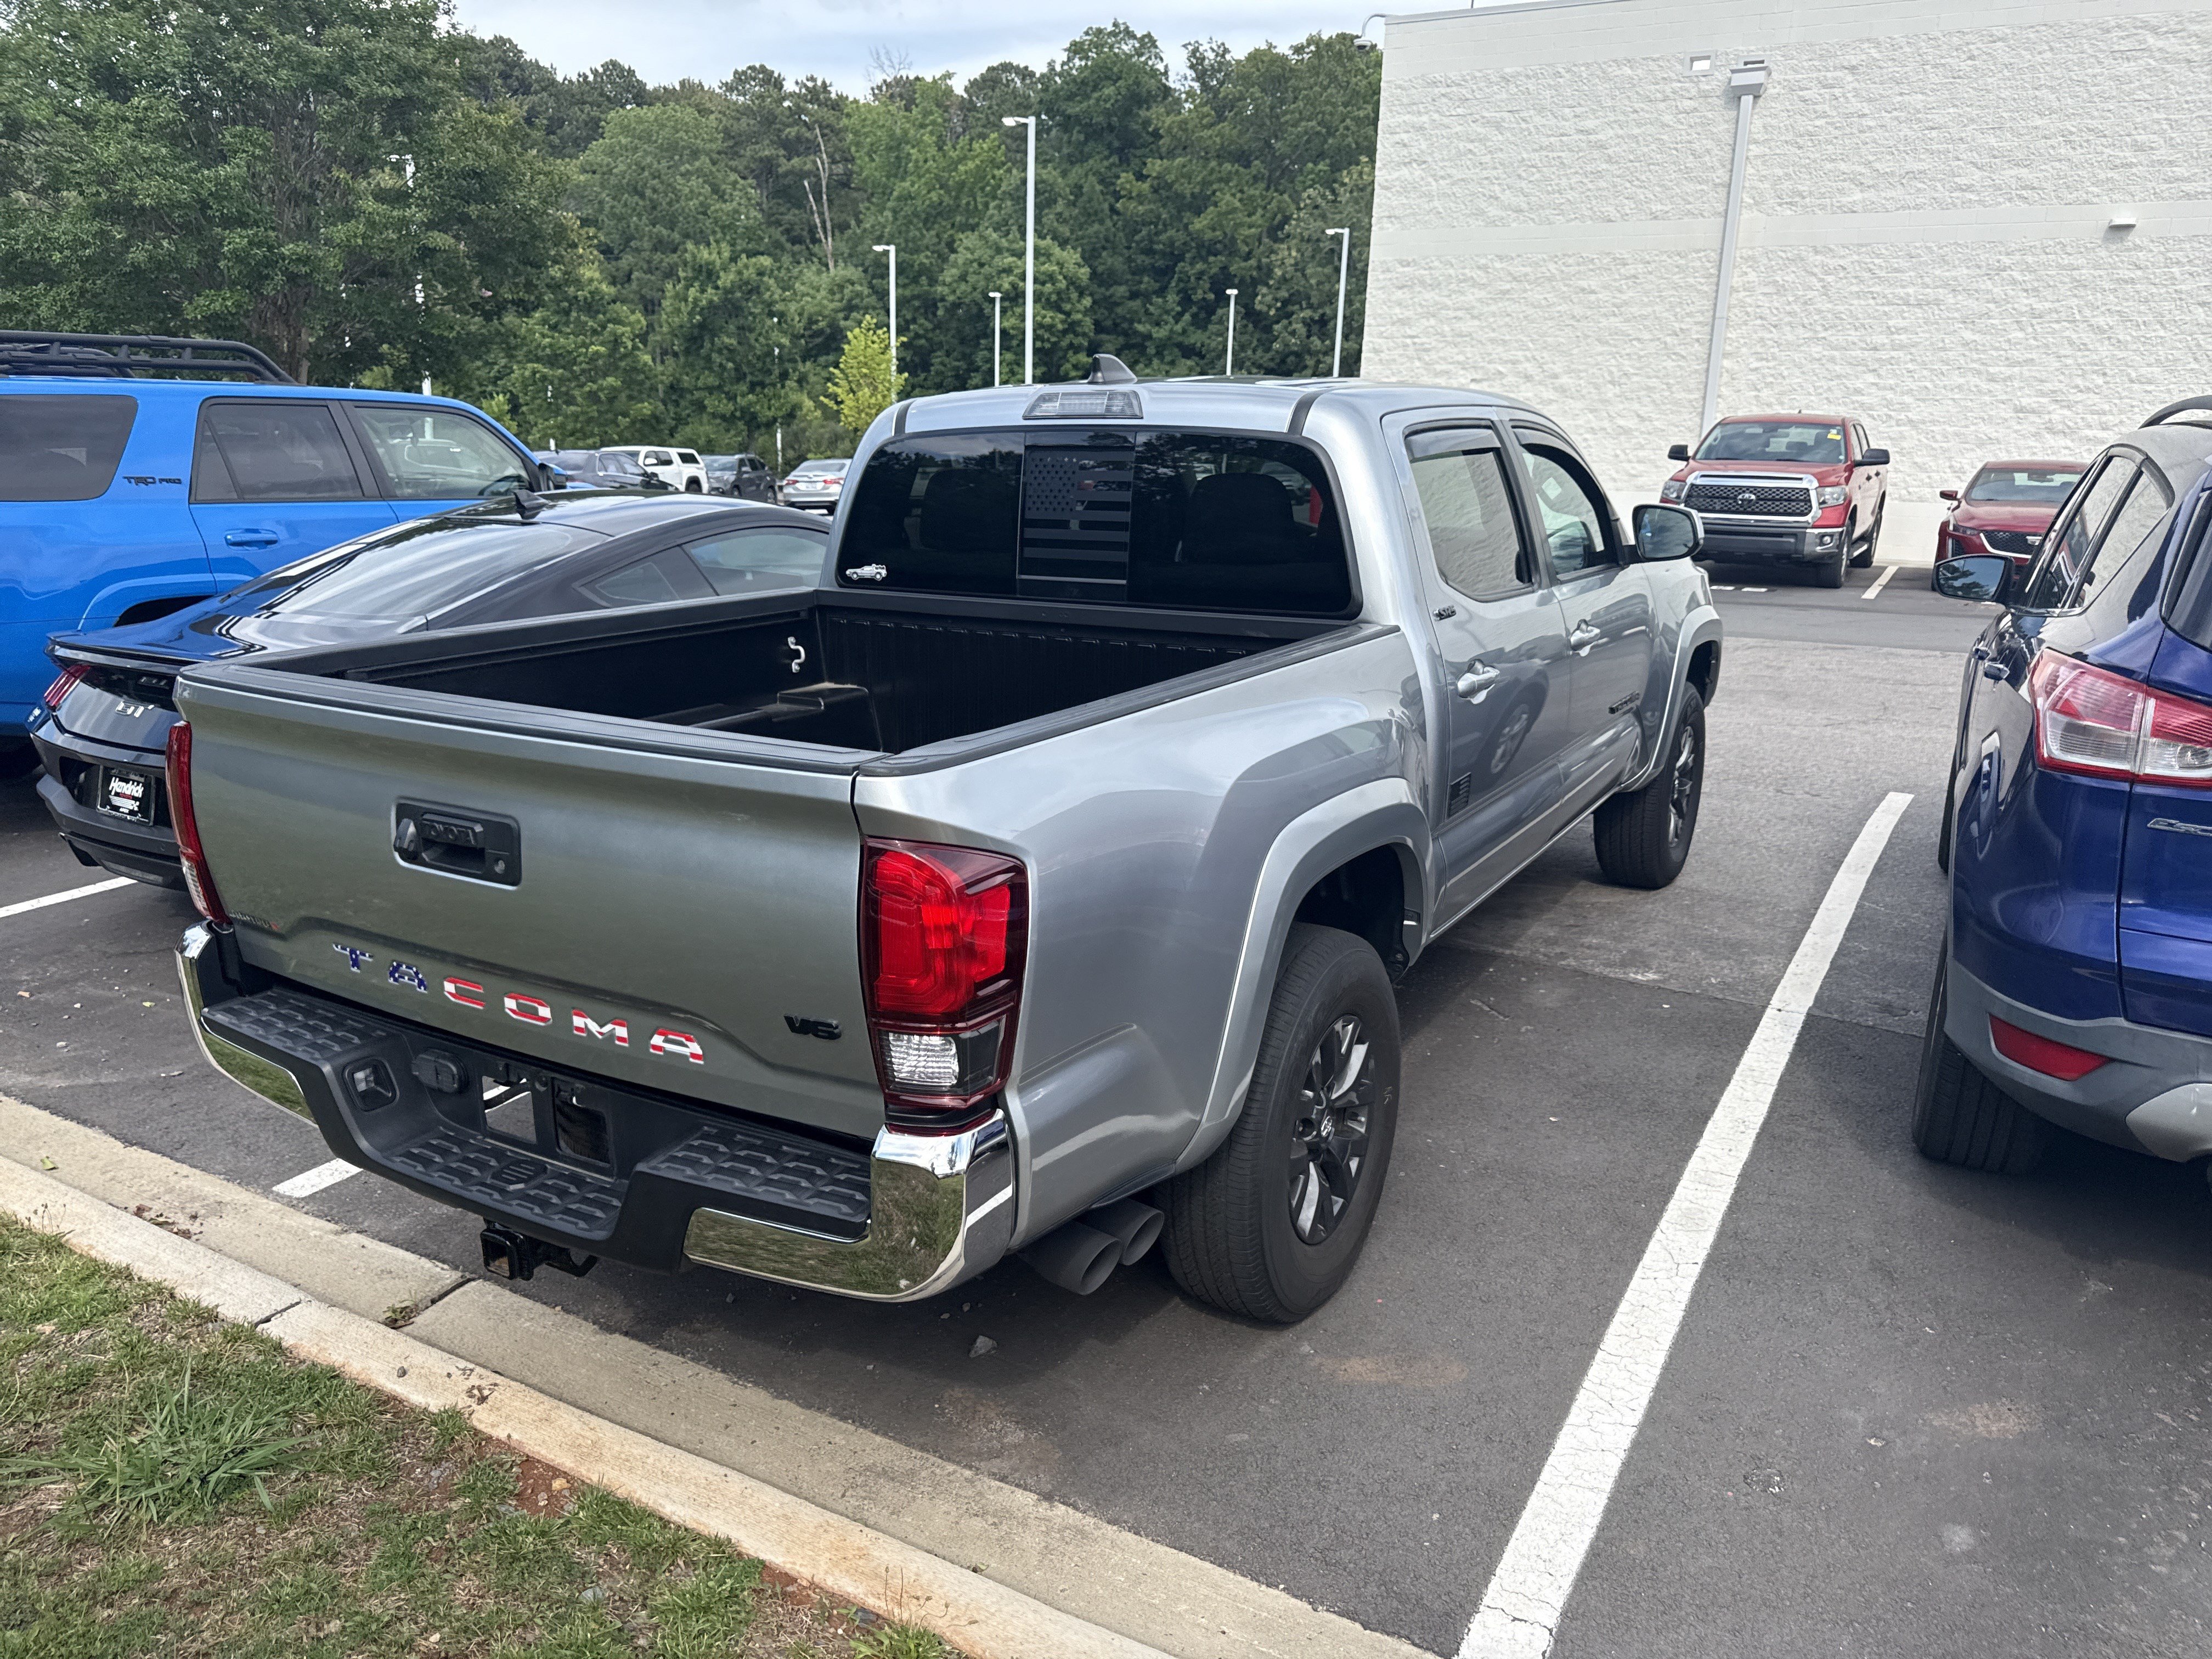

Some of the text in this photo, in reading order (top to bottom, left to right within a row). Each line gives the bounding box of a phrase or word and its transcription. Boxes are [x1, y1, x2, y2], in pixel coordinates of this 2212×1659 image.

[109, 777, 144, 798] Hendrick
[332, 944, 704, 1064] TACOMA
[783, 1015, 842, 1040] V6
